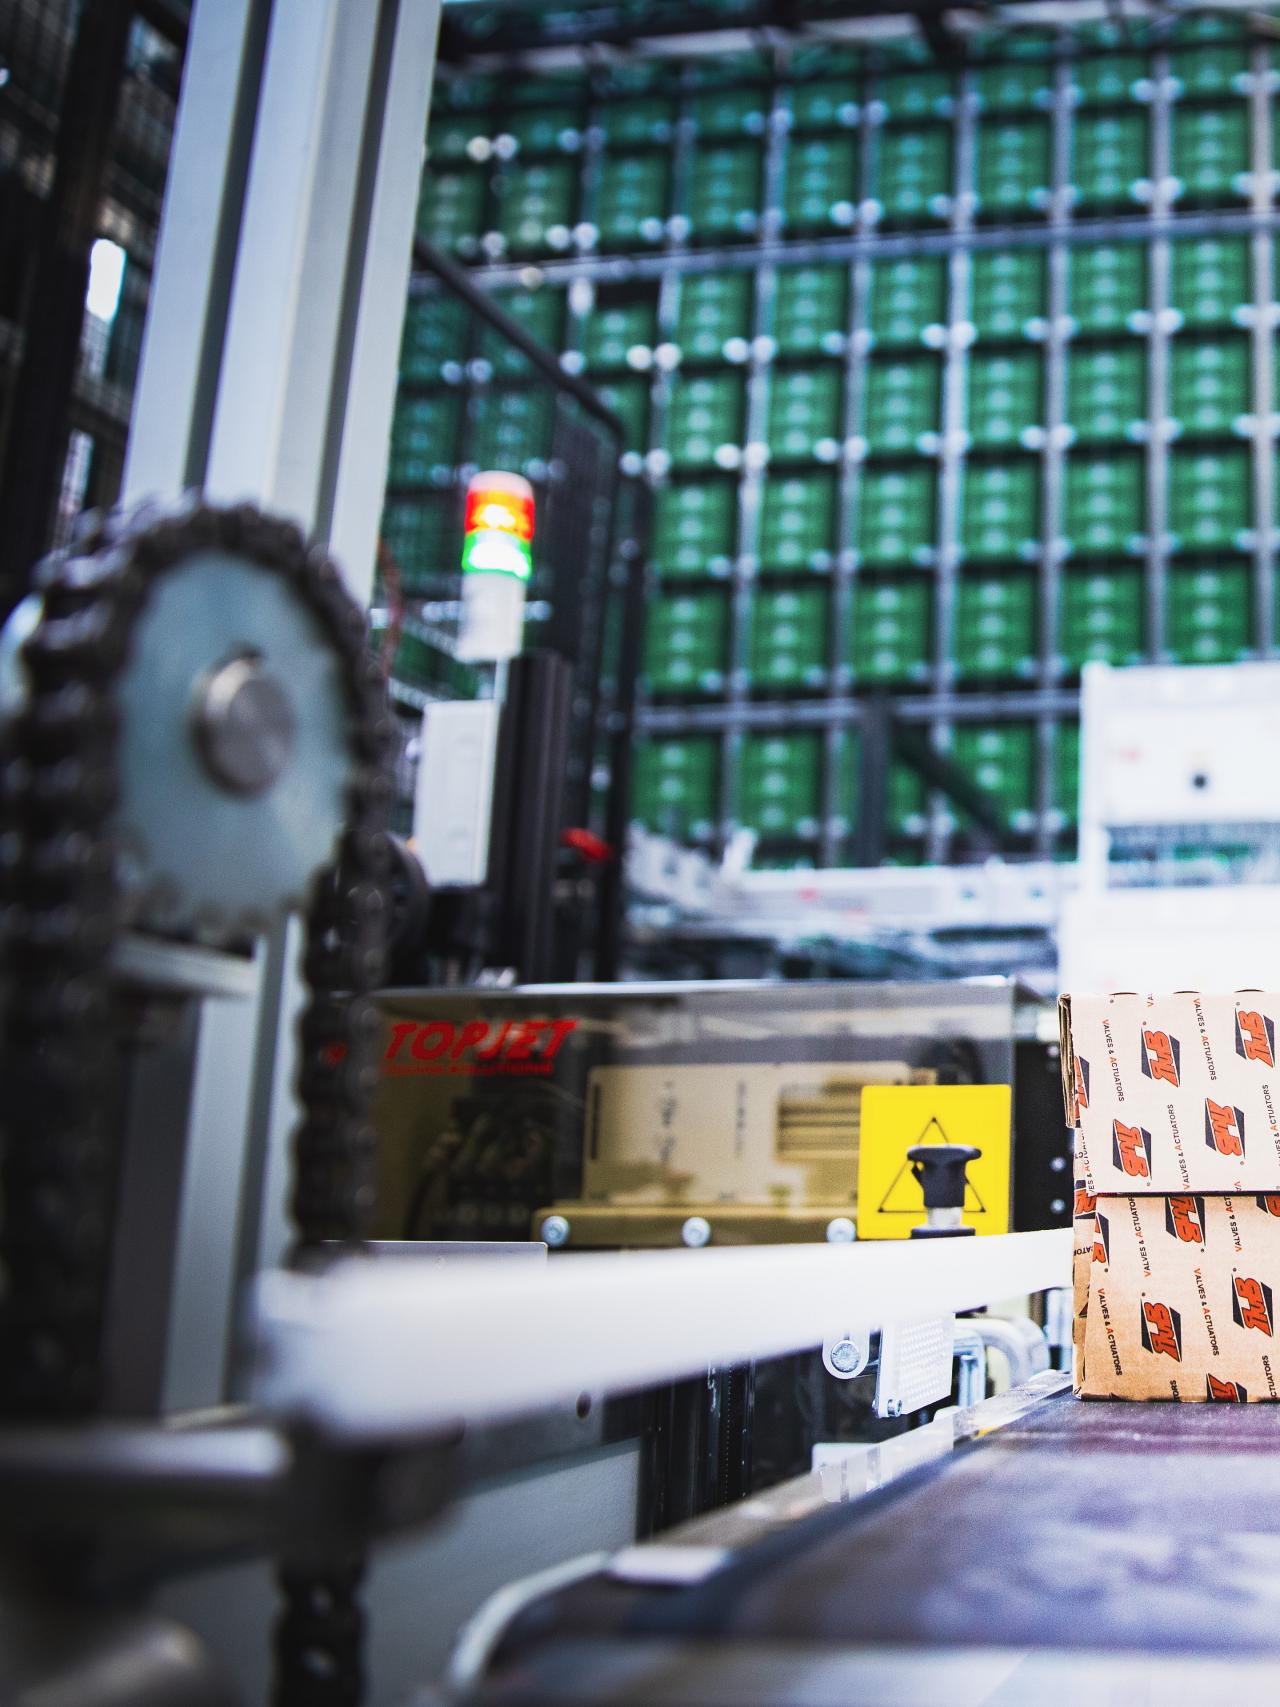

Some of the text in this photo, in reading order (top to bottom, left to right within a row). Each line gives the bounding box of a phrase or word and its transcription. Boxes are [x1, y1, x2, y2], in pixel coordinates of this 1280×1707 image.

[384, 1020, 577, 1060] TOPJET
[1102, 1019, 1114, 1048] VALVES
[1110, 1057, 1124, 1101] ACTUATORS
[1193, 998, 1205, 1026] VALVES
[1201, 1036, 1217, 1081] ACTUATORS
[1167, 1104, 1183, 1151] ACTUATORS
[1262, 1084, 1278, 1131] ACTUATORS
[1179, 1159, 1190, 1190] VALVES
[1230, 1221, 1243, 1252] VALVES
[1140, 1247, 1152, 1278] VALVES
[1097, 1288, 1110, 1319] VALVES
[1106, 1327, 1123, 1376] ACTUATORS
[1194, 1268, 1206, 1300] VALVES
[1202, 1307, 1220, 1356] ACTUATORS
[1262, 1355, 1277, 1399] CTUATORS
